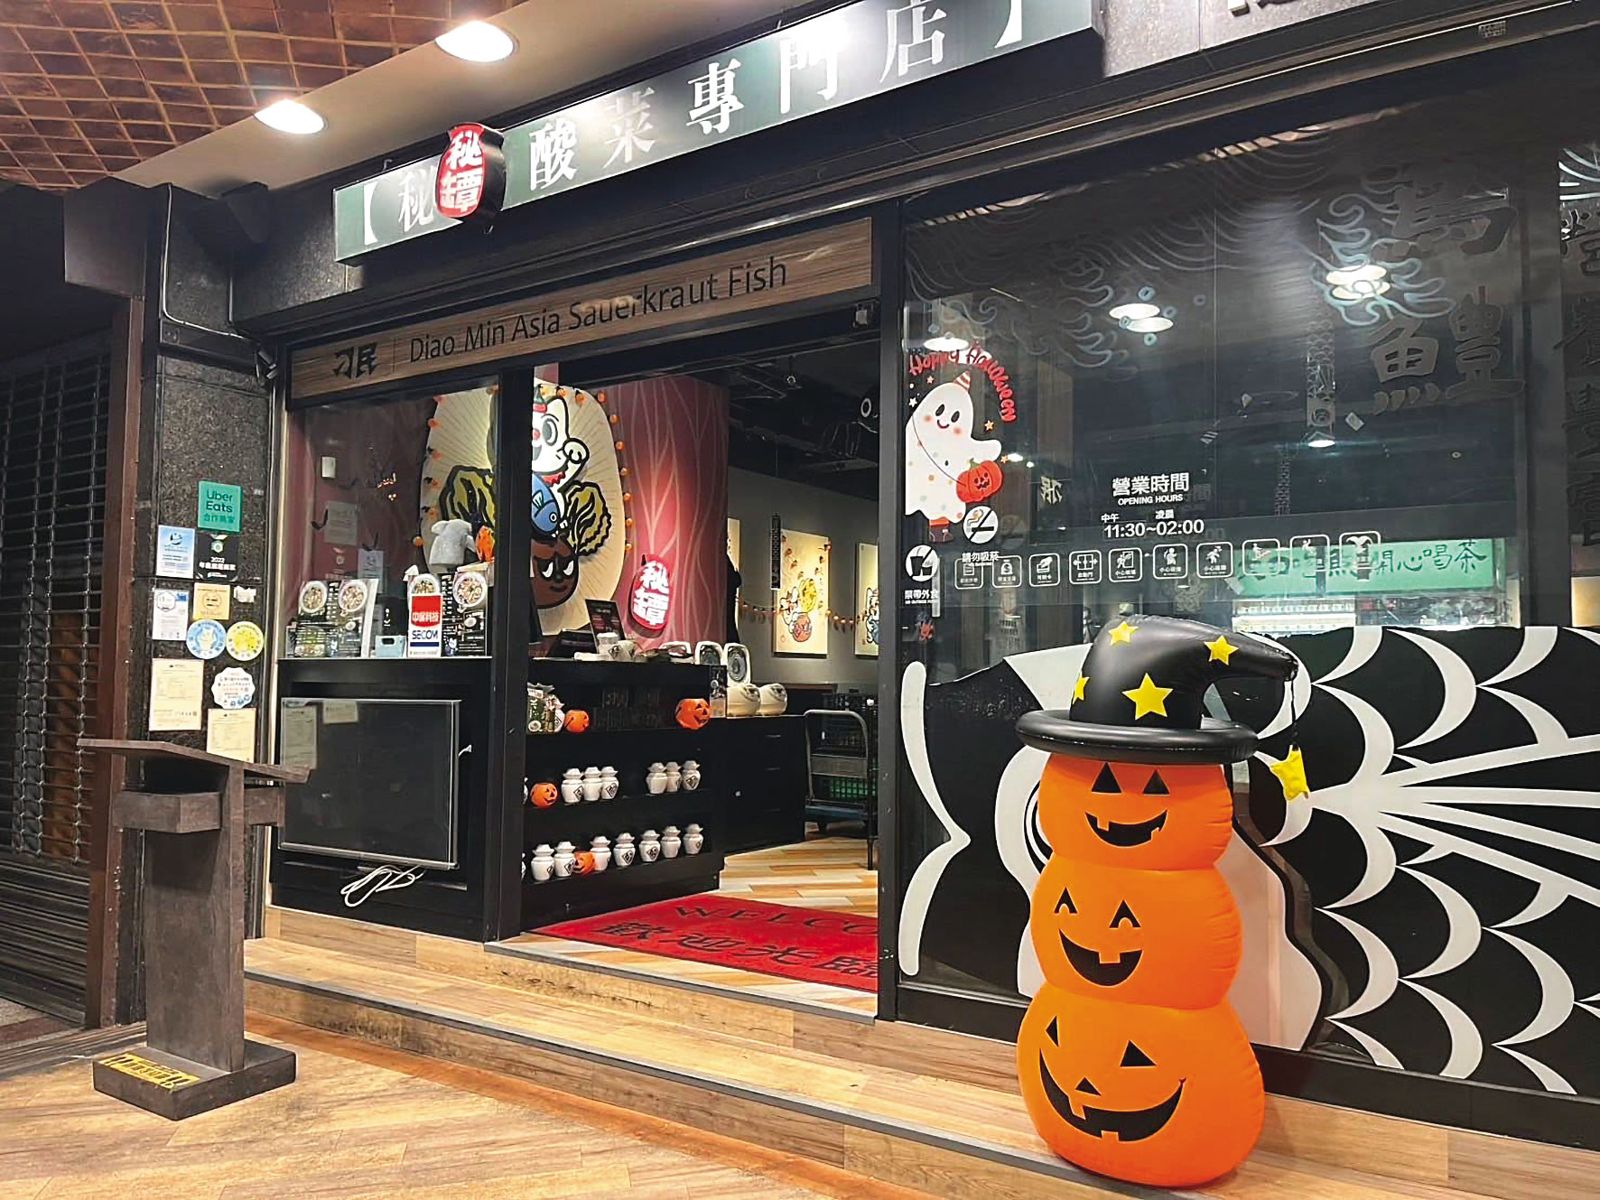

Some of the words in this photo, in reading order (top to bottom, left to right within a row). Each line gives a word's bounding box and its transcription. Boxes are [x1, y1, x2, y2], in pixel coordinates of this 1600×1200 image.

[410, 334, 455, 362] Diao
[464, 320, 505, 352] Min
[511, 308, 560, 342] Asia
[568, 273, 718, 330] Sauerkraut
[729, 256, 786, 297] Fish
[909, 351, 961, 375] Happy
[965, 345, 1017, 423] Halloween
[1112, 472, 1190, 497] 營業時間
[206, 488, 233, 502] Uber
[1118, 496, 1153, 506] OPENING
[1155, 493, 1184, 504] HOURS
[205, 500, 233, 513] Eats
[1100, 513, 1120, 523] 中午
[1103, 519, 1205, 538] 11:30~02:00
[412, 629, 439, 640] SECOM
